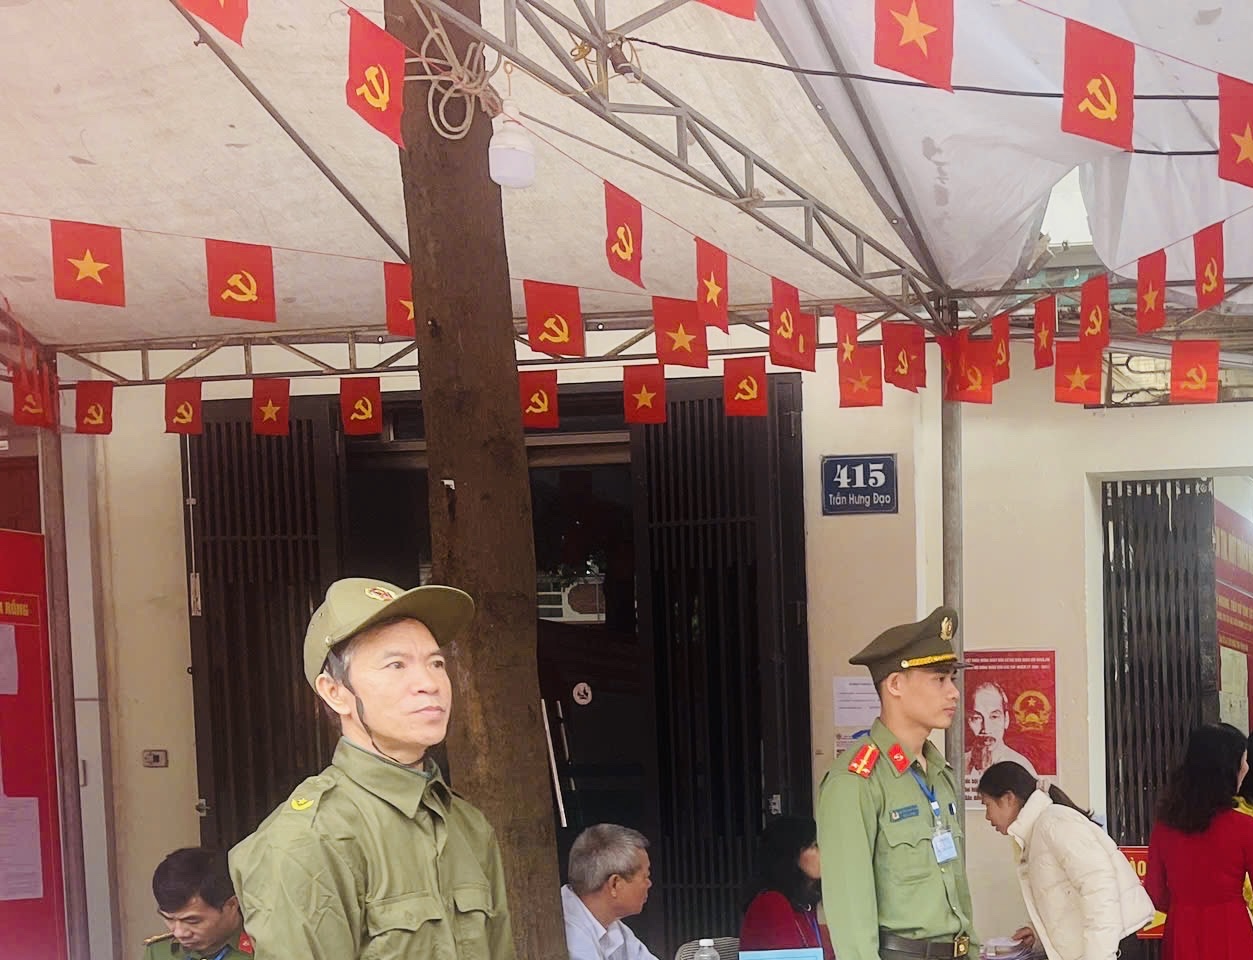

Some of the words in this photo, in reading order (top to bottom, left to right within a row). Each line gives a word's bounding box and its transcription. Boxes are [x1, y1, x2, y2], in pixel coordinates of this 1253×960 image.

[832, 463, 886, 488] 415
[829, 491, 847, 505] Trần
[848, 493, 871, 507] Hưng
[873, 492, 891, 506] Đạo
